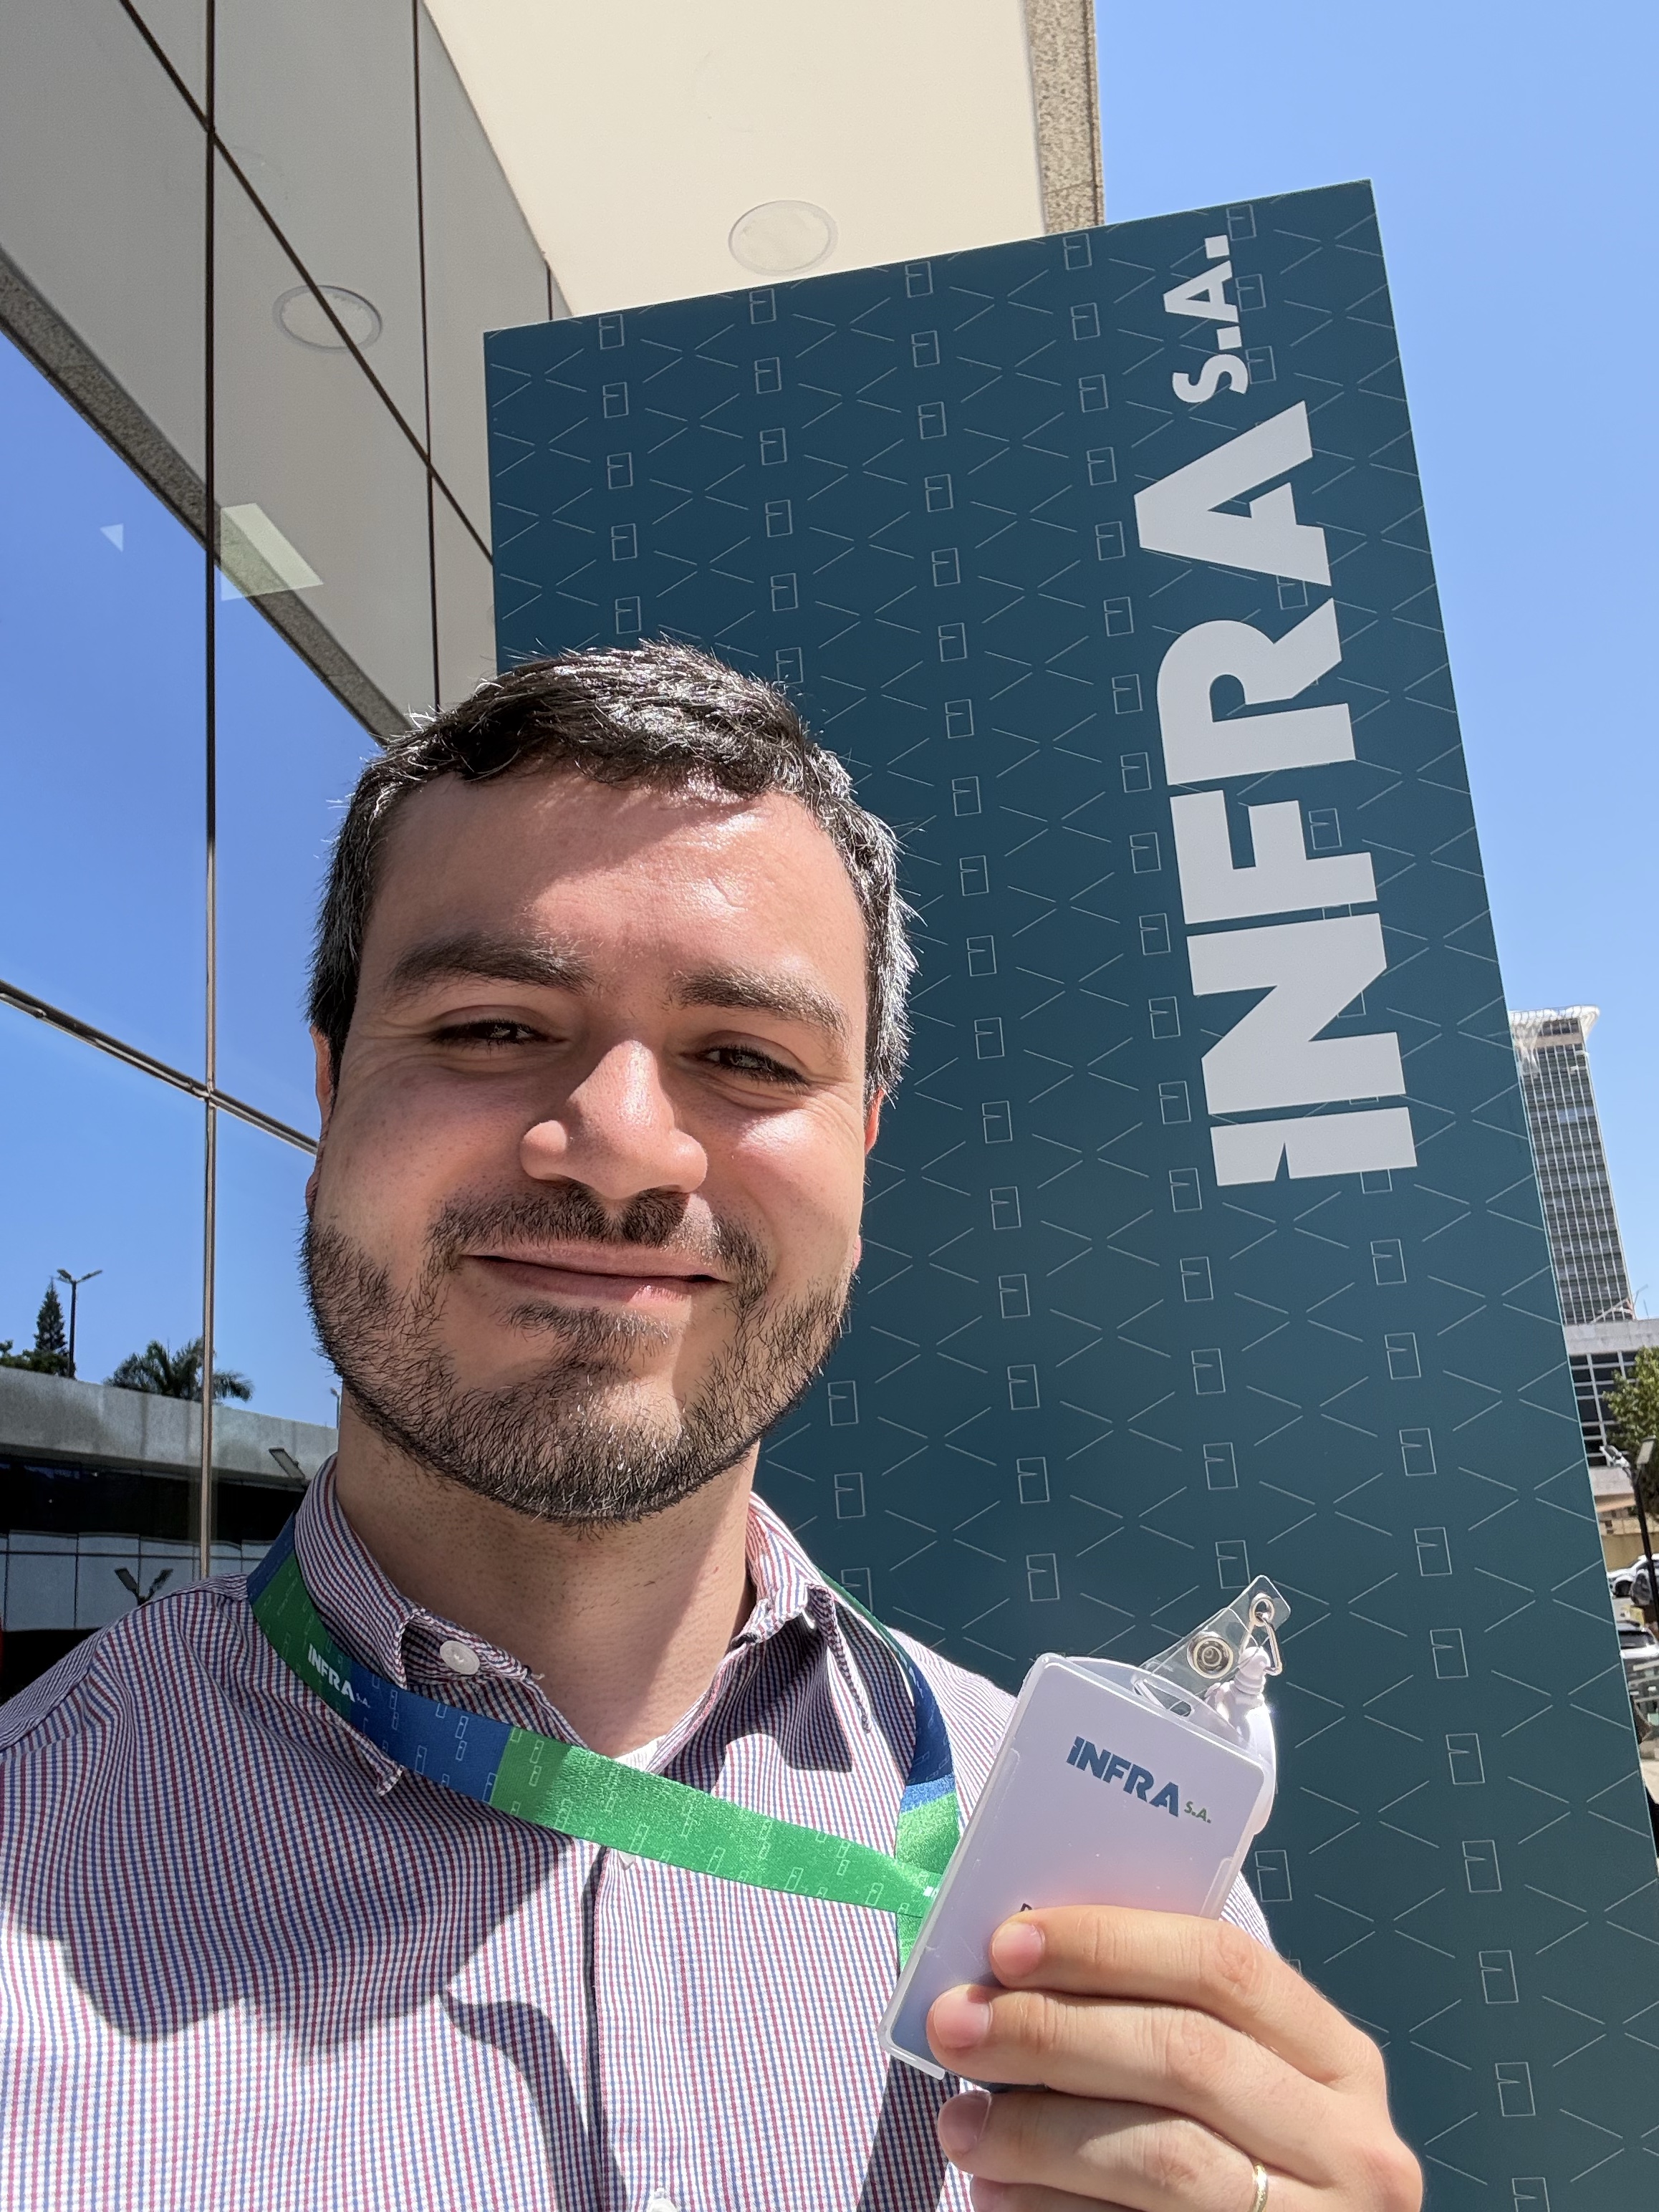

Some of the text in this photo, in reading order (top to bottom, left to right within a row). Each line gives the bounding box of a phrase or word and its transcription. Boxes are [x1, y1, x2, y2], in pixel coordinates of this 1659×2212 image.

[1134, 234, 1418, 1186] INFRA S.A.
[308, 1643, 355, 1702] INFRA
[1066, 1736, 1212, 1824] INFRA S.A.
